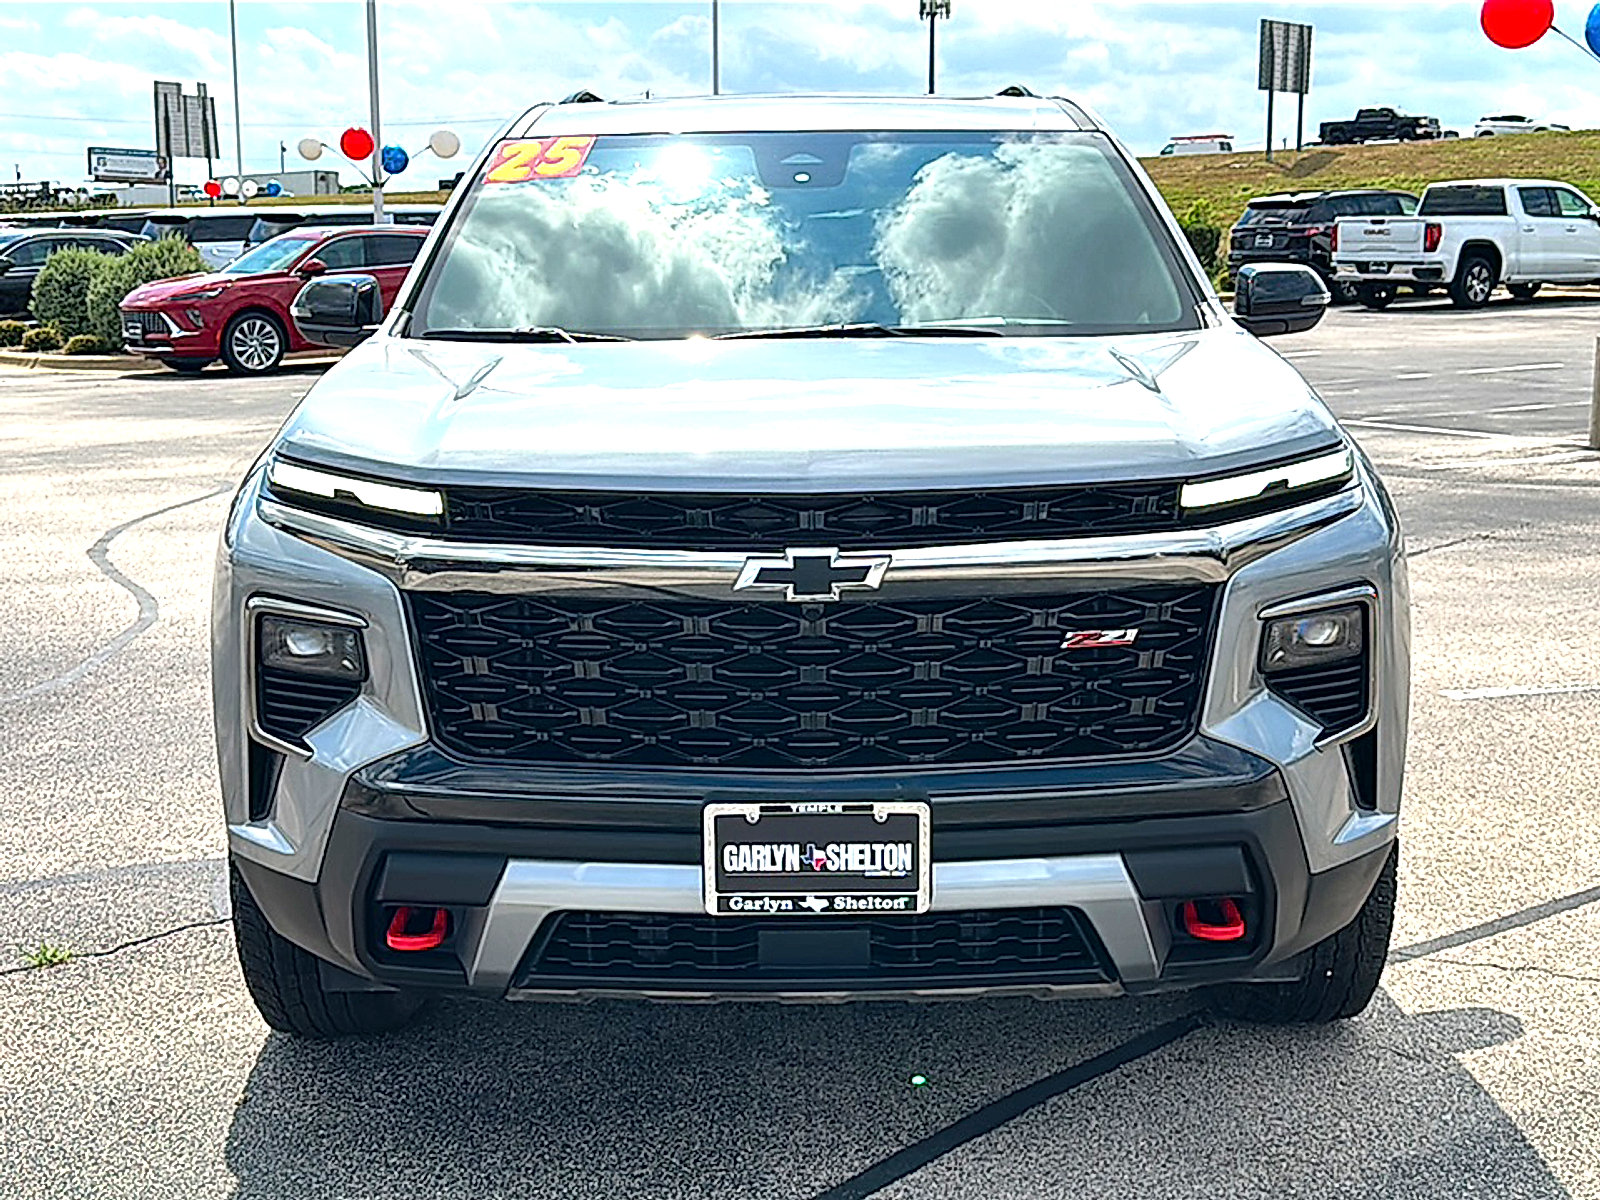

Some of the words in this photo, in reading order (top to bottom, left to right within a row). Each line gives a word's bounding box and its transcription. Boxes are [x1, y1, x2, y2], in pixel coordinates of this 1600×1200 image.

[487, 136, 591, 181] 25
[1060, 628, 1138, 649] Z71
[723, 844, 800, 872] GARLYN
[826, 843, 912, 871] SHELTON
[729, 896, 793, 913] Garlyn
[833, 896, 907, 910] Shelton
